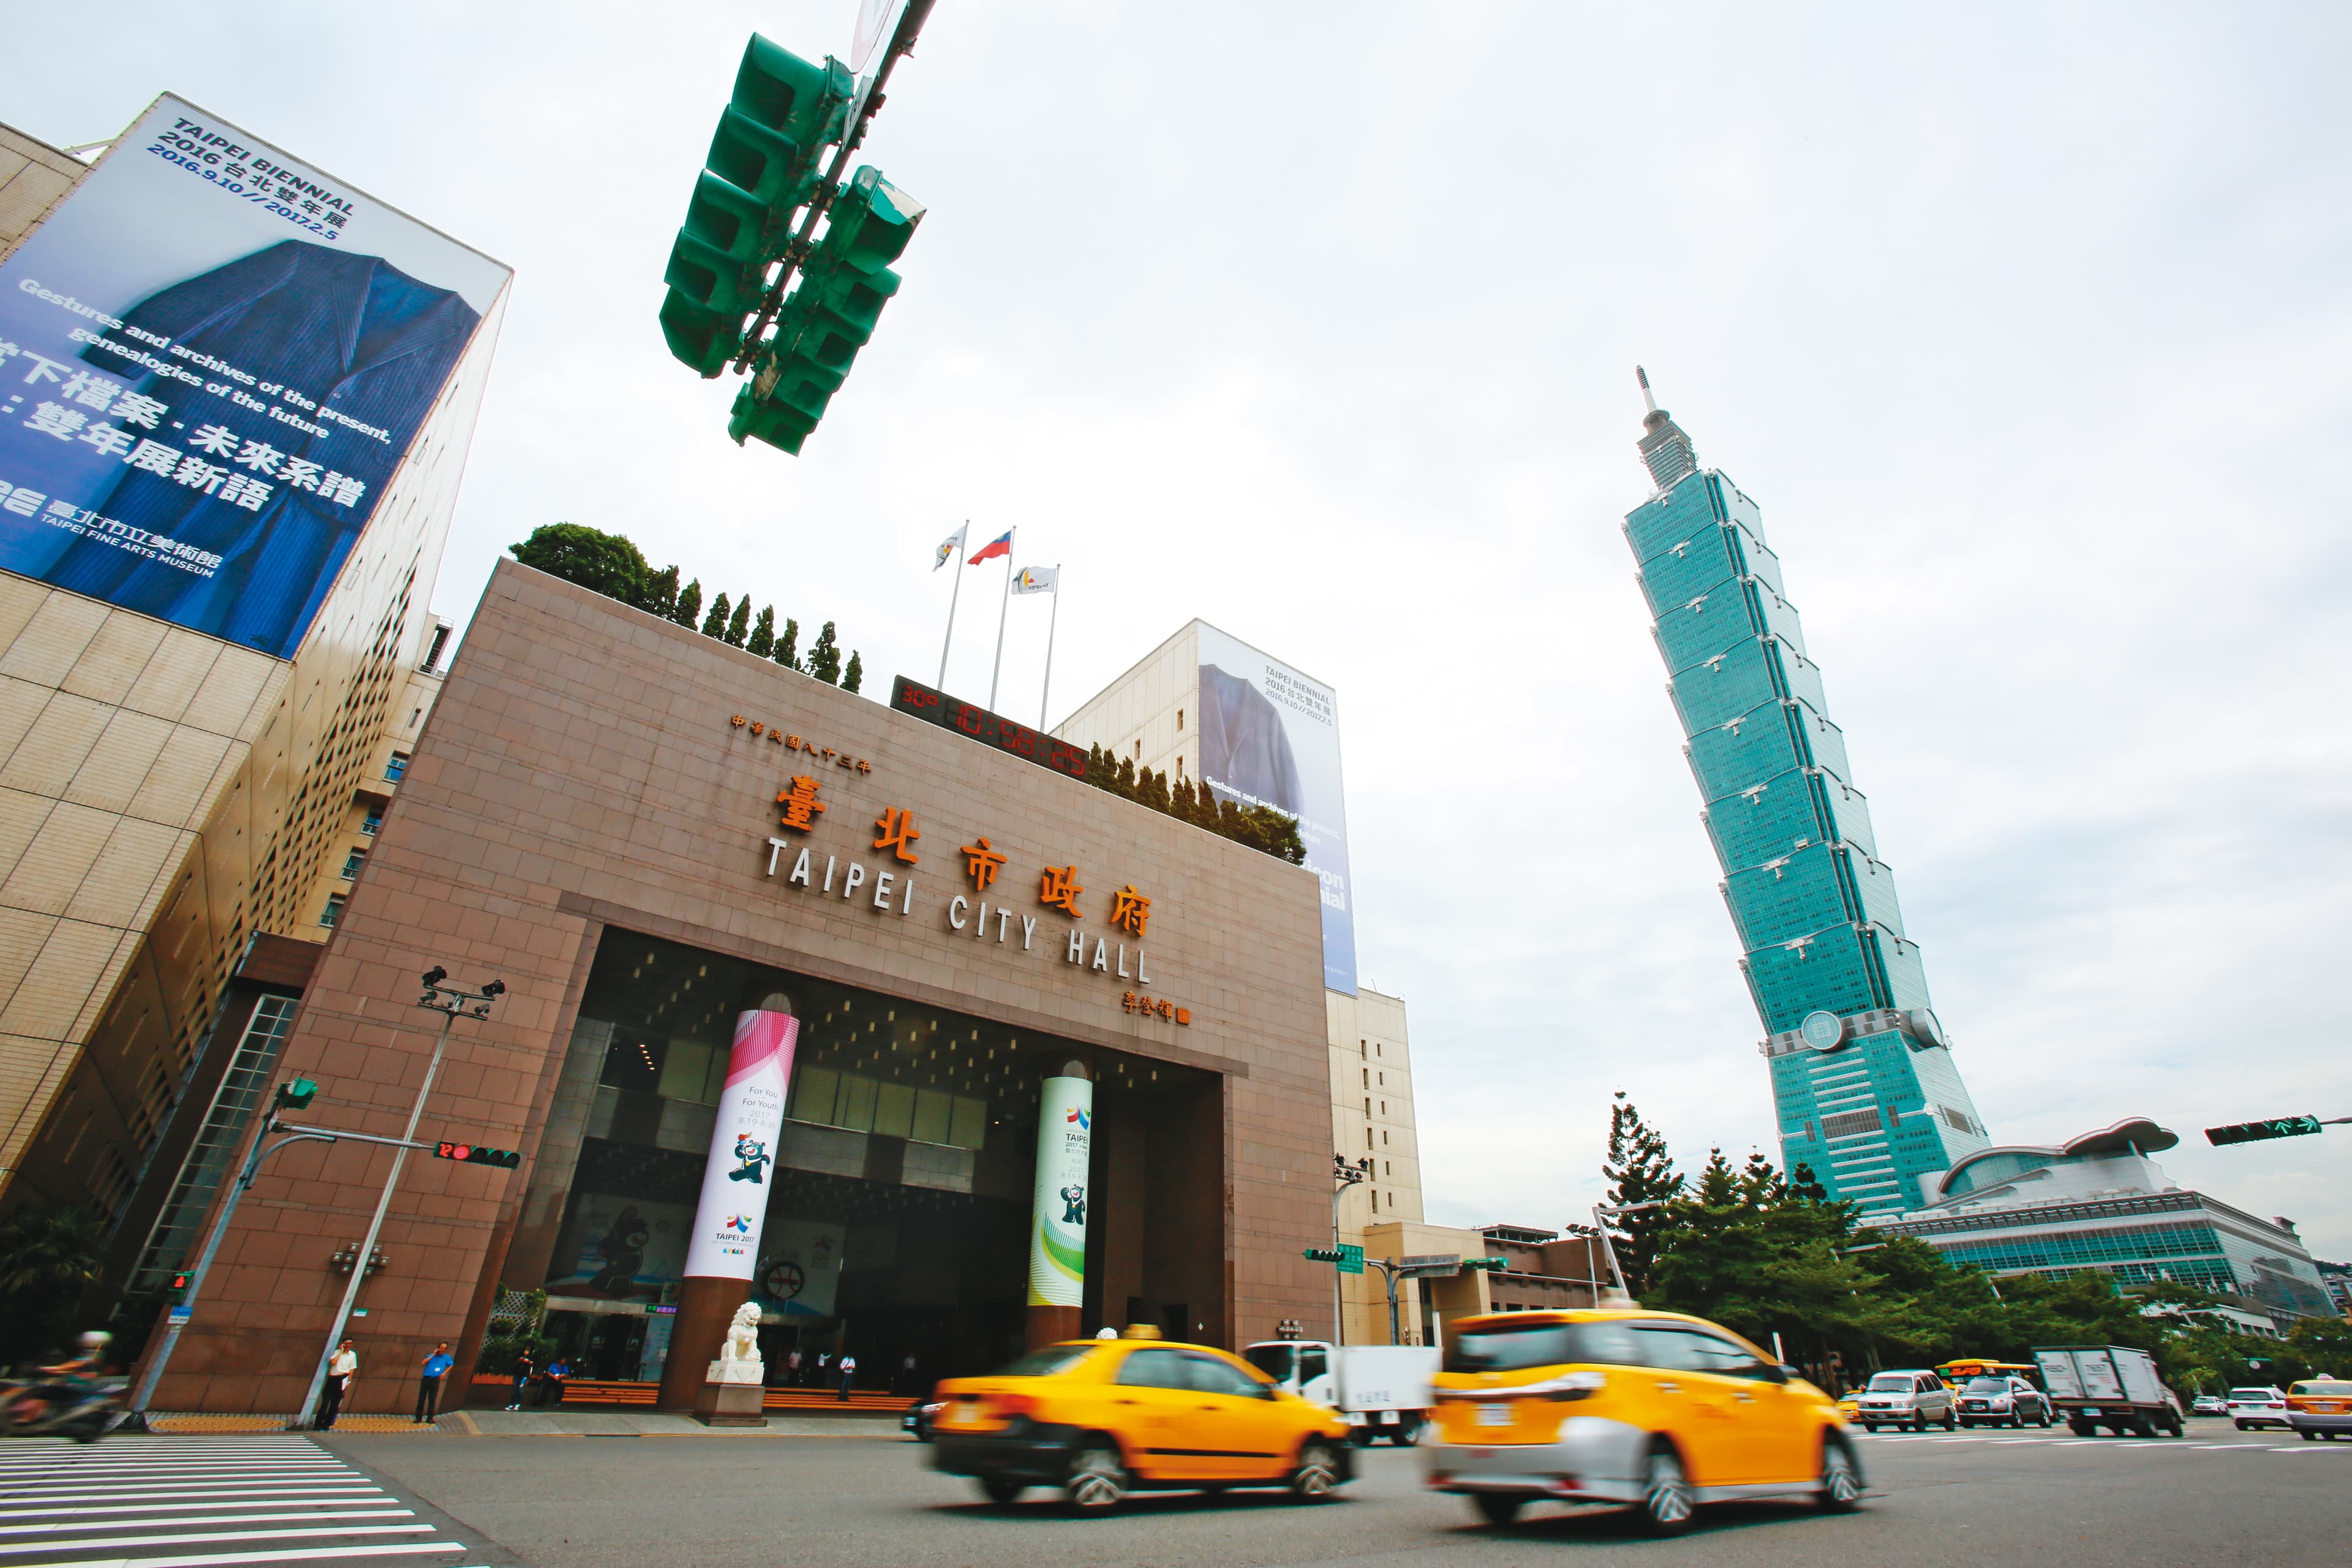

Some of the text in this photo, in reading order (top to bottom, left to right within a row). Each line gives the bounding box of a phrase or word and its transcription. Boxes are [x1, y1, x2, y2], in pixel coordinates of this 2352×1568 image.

[157, 131, 349, 229] 2016 台北雙年展
[173, 118, 353, 216] TAIPEI BIENNIAL
[19, 279, 392, 445] Gestures and archives of the present,
[68, 327, 330, 439] genealogies of the future
[40, 513, 214, 578] TAIPEI FINE ARTS MUSEUM
[47, 499, 224, 569] 臺北市立美術館
[1265, 677, 1286, 693] 2016
[1265, 665, 1330, 706] TAIPEI BIENNIAL
[731, 714, 872, 775] 中華民國八十三年
[1206, 775, 1242, 798] Gestures
[1242, 793, 1257, 805] and
[1258, 799, 1289, 818] archives
[1289, 810, 1298, 821] of
[1298, 815, 1311, 827] the
[777, 774, 1152, 938] 臺北市政府
[767, 836, 1151, 984] TAIPEI CITY HALL
[742, 1098, 779, 1111] For Youth
[749, 1087, 778, 1098] For You
[749, 1109, 771, 1119] 2017
[1066, 1133, 1088, 1144] TAIPEI
